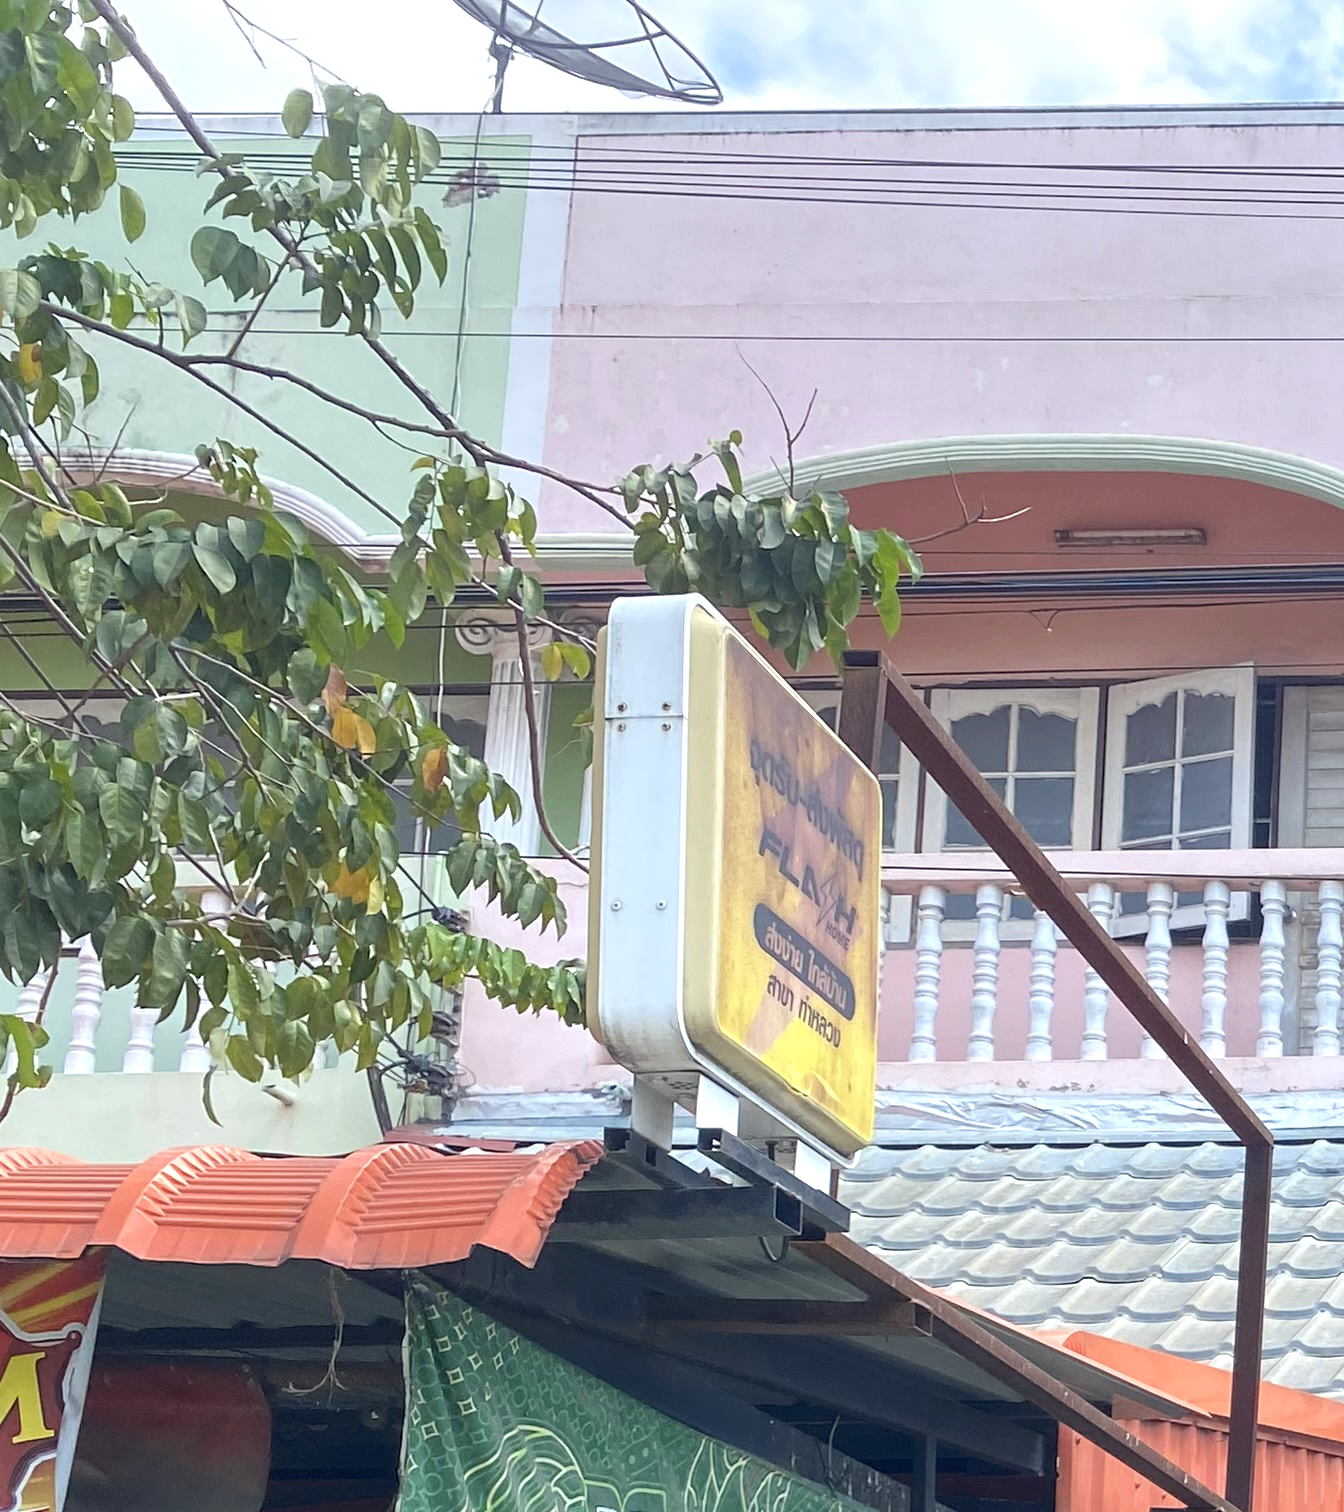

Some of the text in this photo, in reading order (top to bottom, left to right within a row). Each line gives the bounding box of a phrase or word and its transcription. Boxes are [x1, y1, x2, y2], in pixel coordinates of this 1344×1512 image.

[764, 921, 848, 1011] ส่งง่าย ใกล้บ้าน
[825, 920, 851, 951] HOME
[766, 974, 842, 1049] สาขา ท่าหลวง
